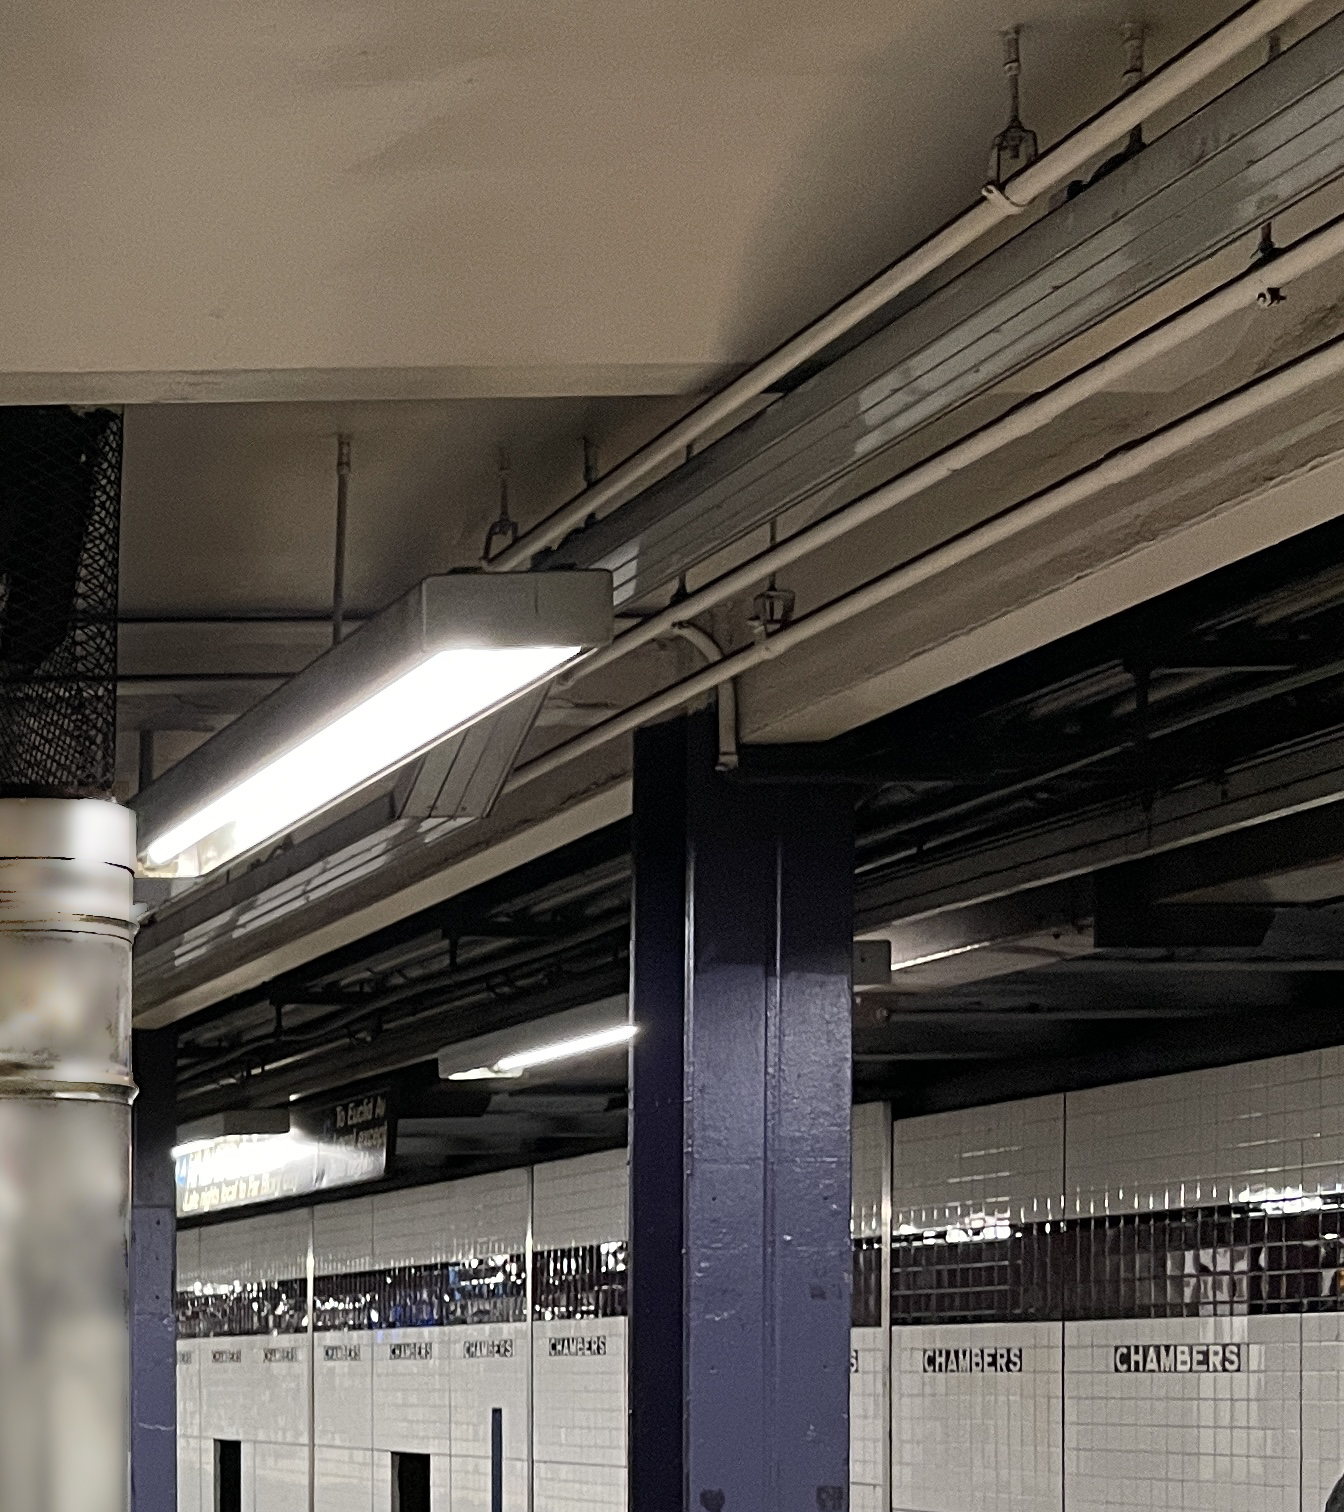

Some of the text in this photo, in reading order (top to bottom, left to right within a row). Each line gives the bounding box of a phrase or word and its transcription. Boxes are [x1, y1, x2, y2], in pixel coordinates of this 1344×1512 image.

[549, 1336, 606, 1356] CHAMBERS
[1115, 1345, 1239, 1372] CHAMBERS
[923, 1348, 1022, 1373] CHAMBERS
